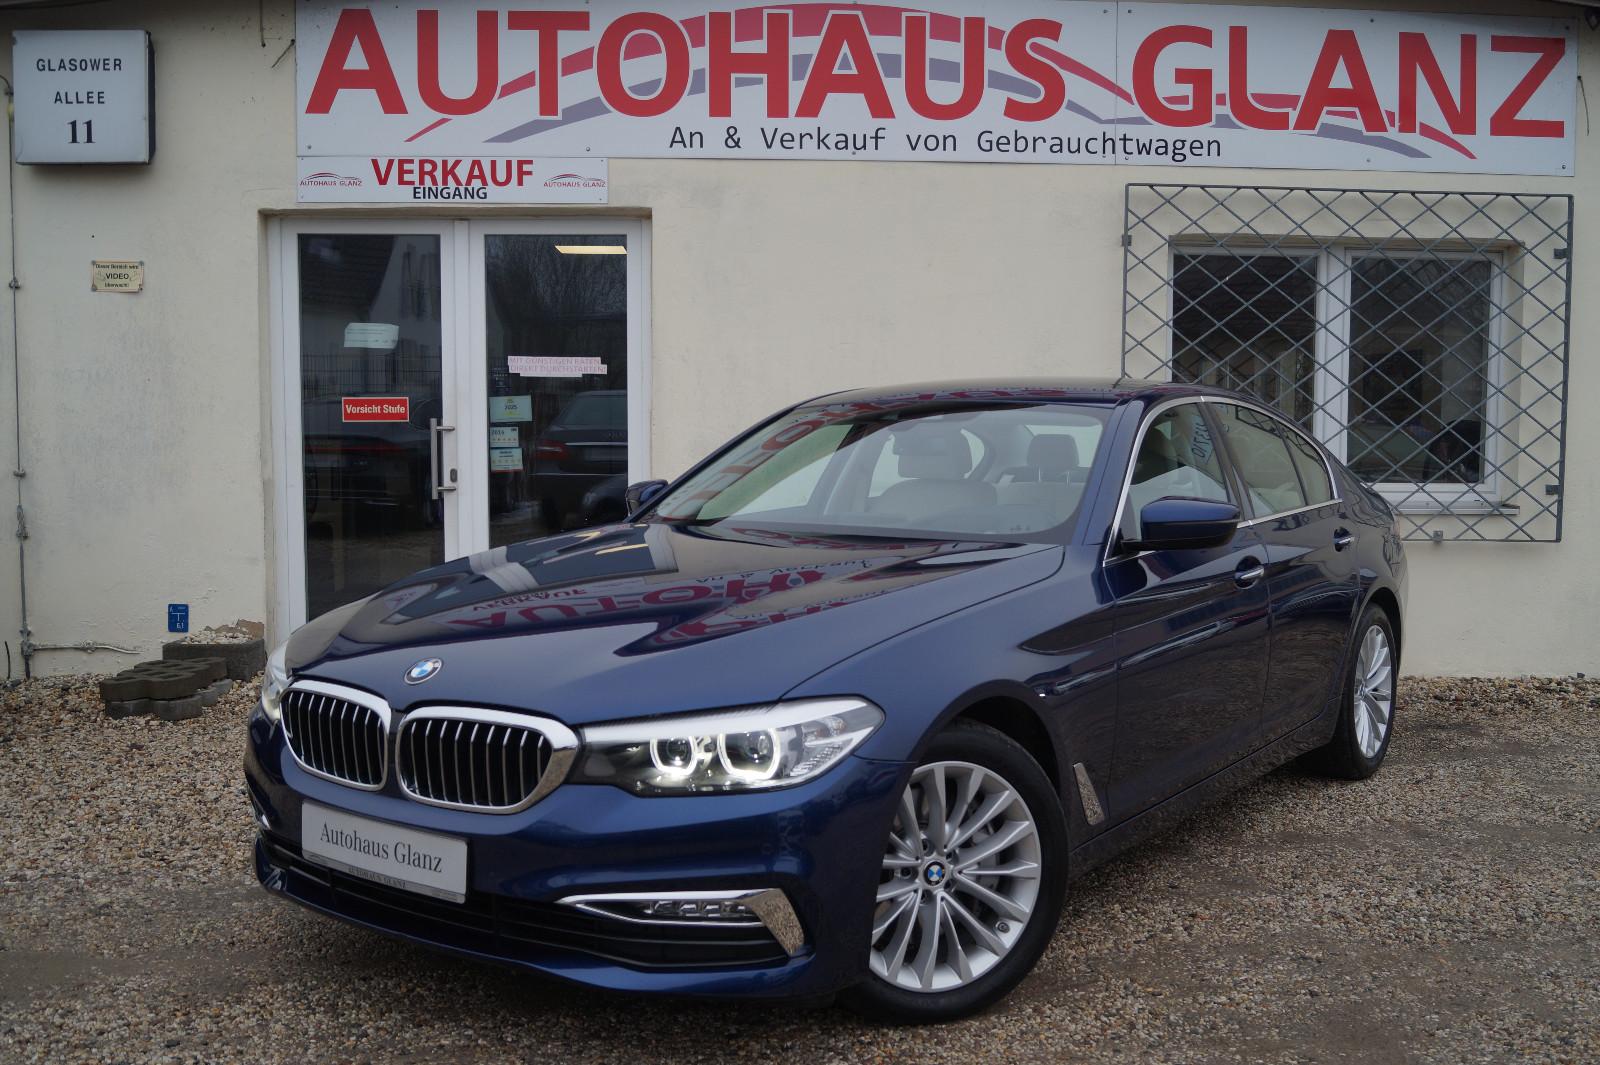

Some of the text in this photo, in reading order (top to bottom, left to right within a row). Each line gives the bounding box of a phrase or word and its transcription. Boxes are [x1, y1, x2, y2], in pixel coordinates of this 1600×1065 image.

[36, 58, 122, 72] GLASOWER
[305, 8, 1566, 139] AUTOHAUS GLANZ
[54, 91, 106, 105] ALLEE
[67, 119, 96, 144] 11
[669, 126, 1222, 162] An & Verkauf von Gebrauchtwagen
[371, 158, 534, 187] VERKAUF
[412, 186, 488, 200] EINGANG
[105, 272, 130, 280] VIDEO
[345, 404, 406, 414] Vorsicht Stufe
[320, 822, 443, 873] Autohaus Glanz
